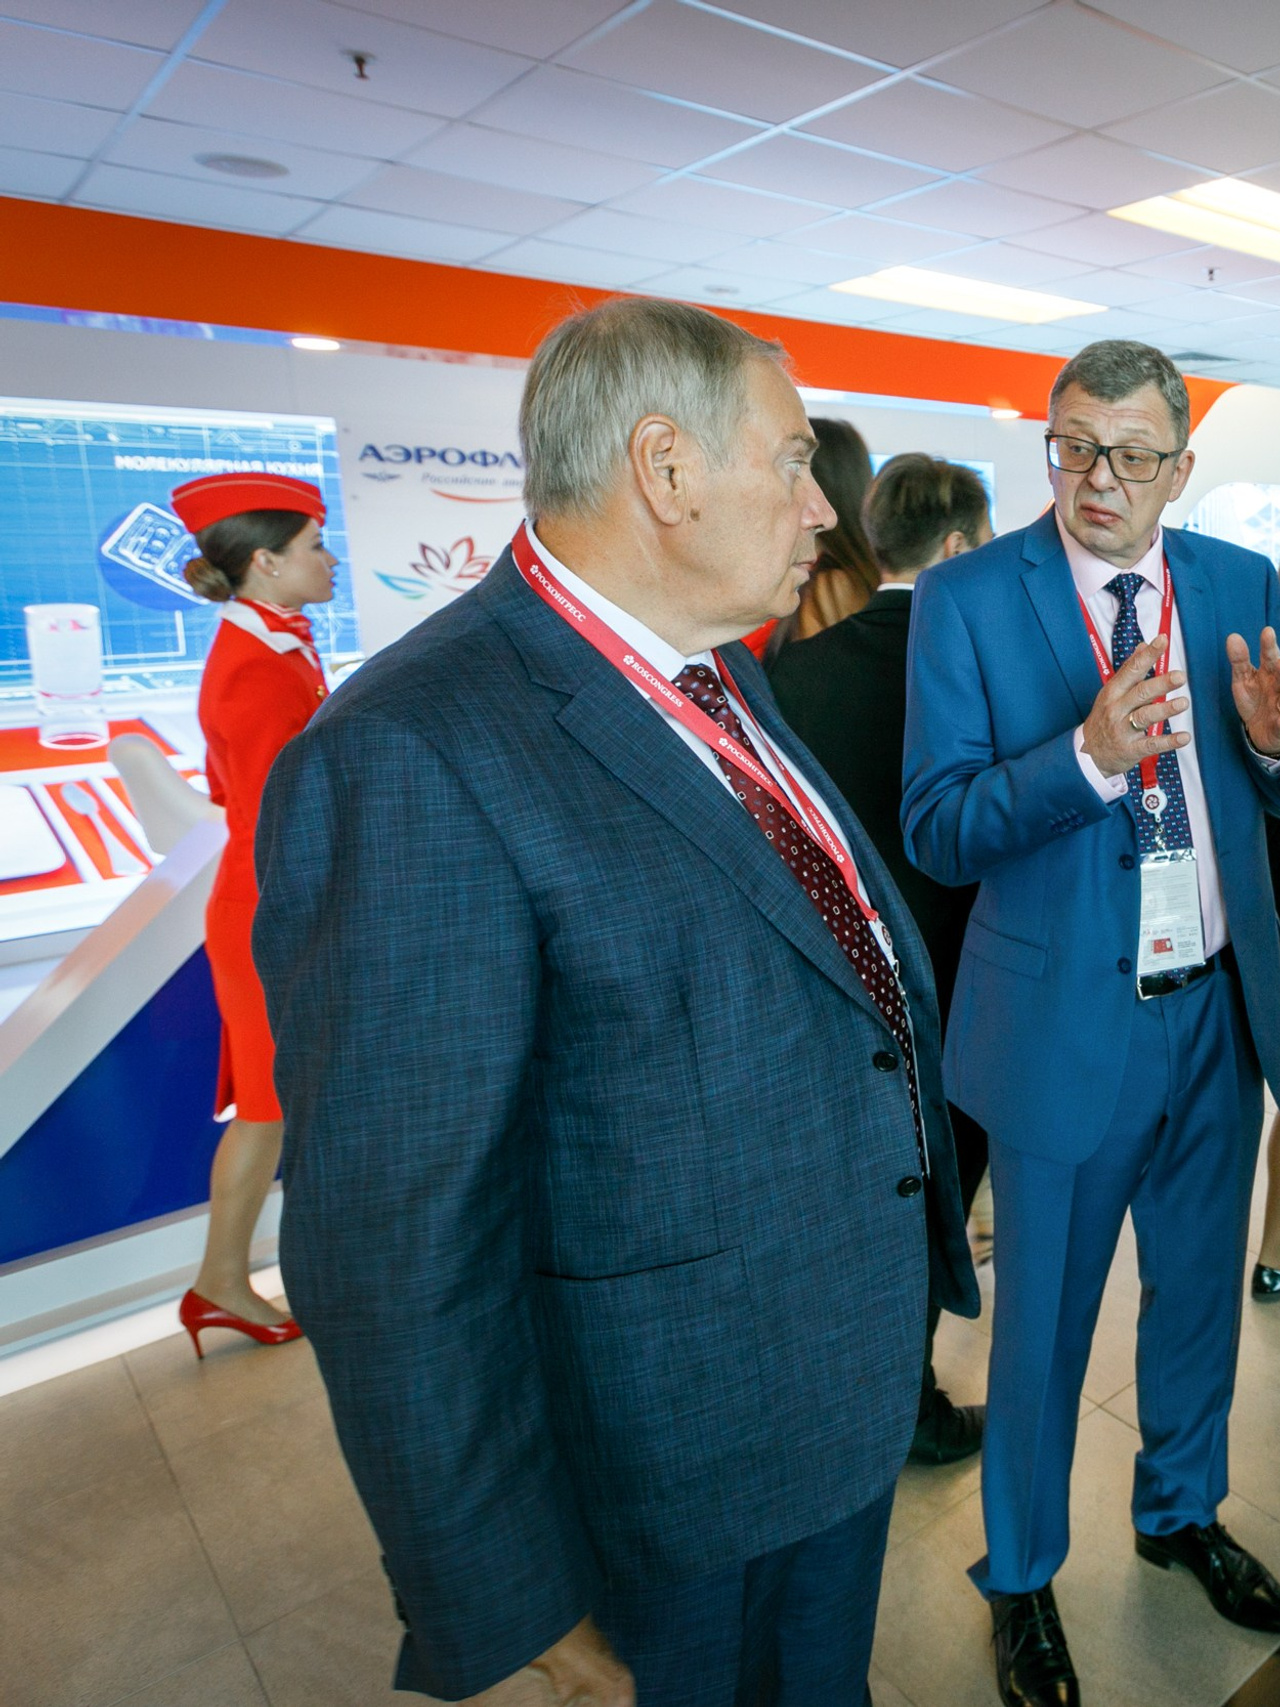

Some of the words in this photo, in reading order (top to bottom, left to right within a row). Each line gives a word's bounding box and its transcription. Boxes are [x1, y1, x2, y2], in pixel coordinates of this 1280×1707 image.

[358, 442, 523, 468] АЭРОФЛ
[535, 571, 586, 622] РОСКОНГРЕСС
[631, 661, 684, 708] ROSCONGRESS
[726, 744, 774, 787] РОСКОНГРЕСС
[806, 806, 840, 855] РОСКОНГРЕСС
